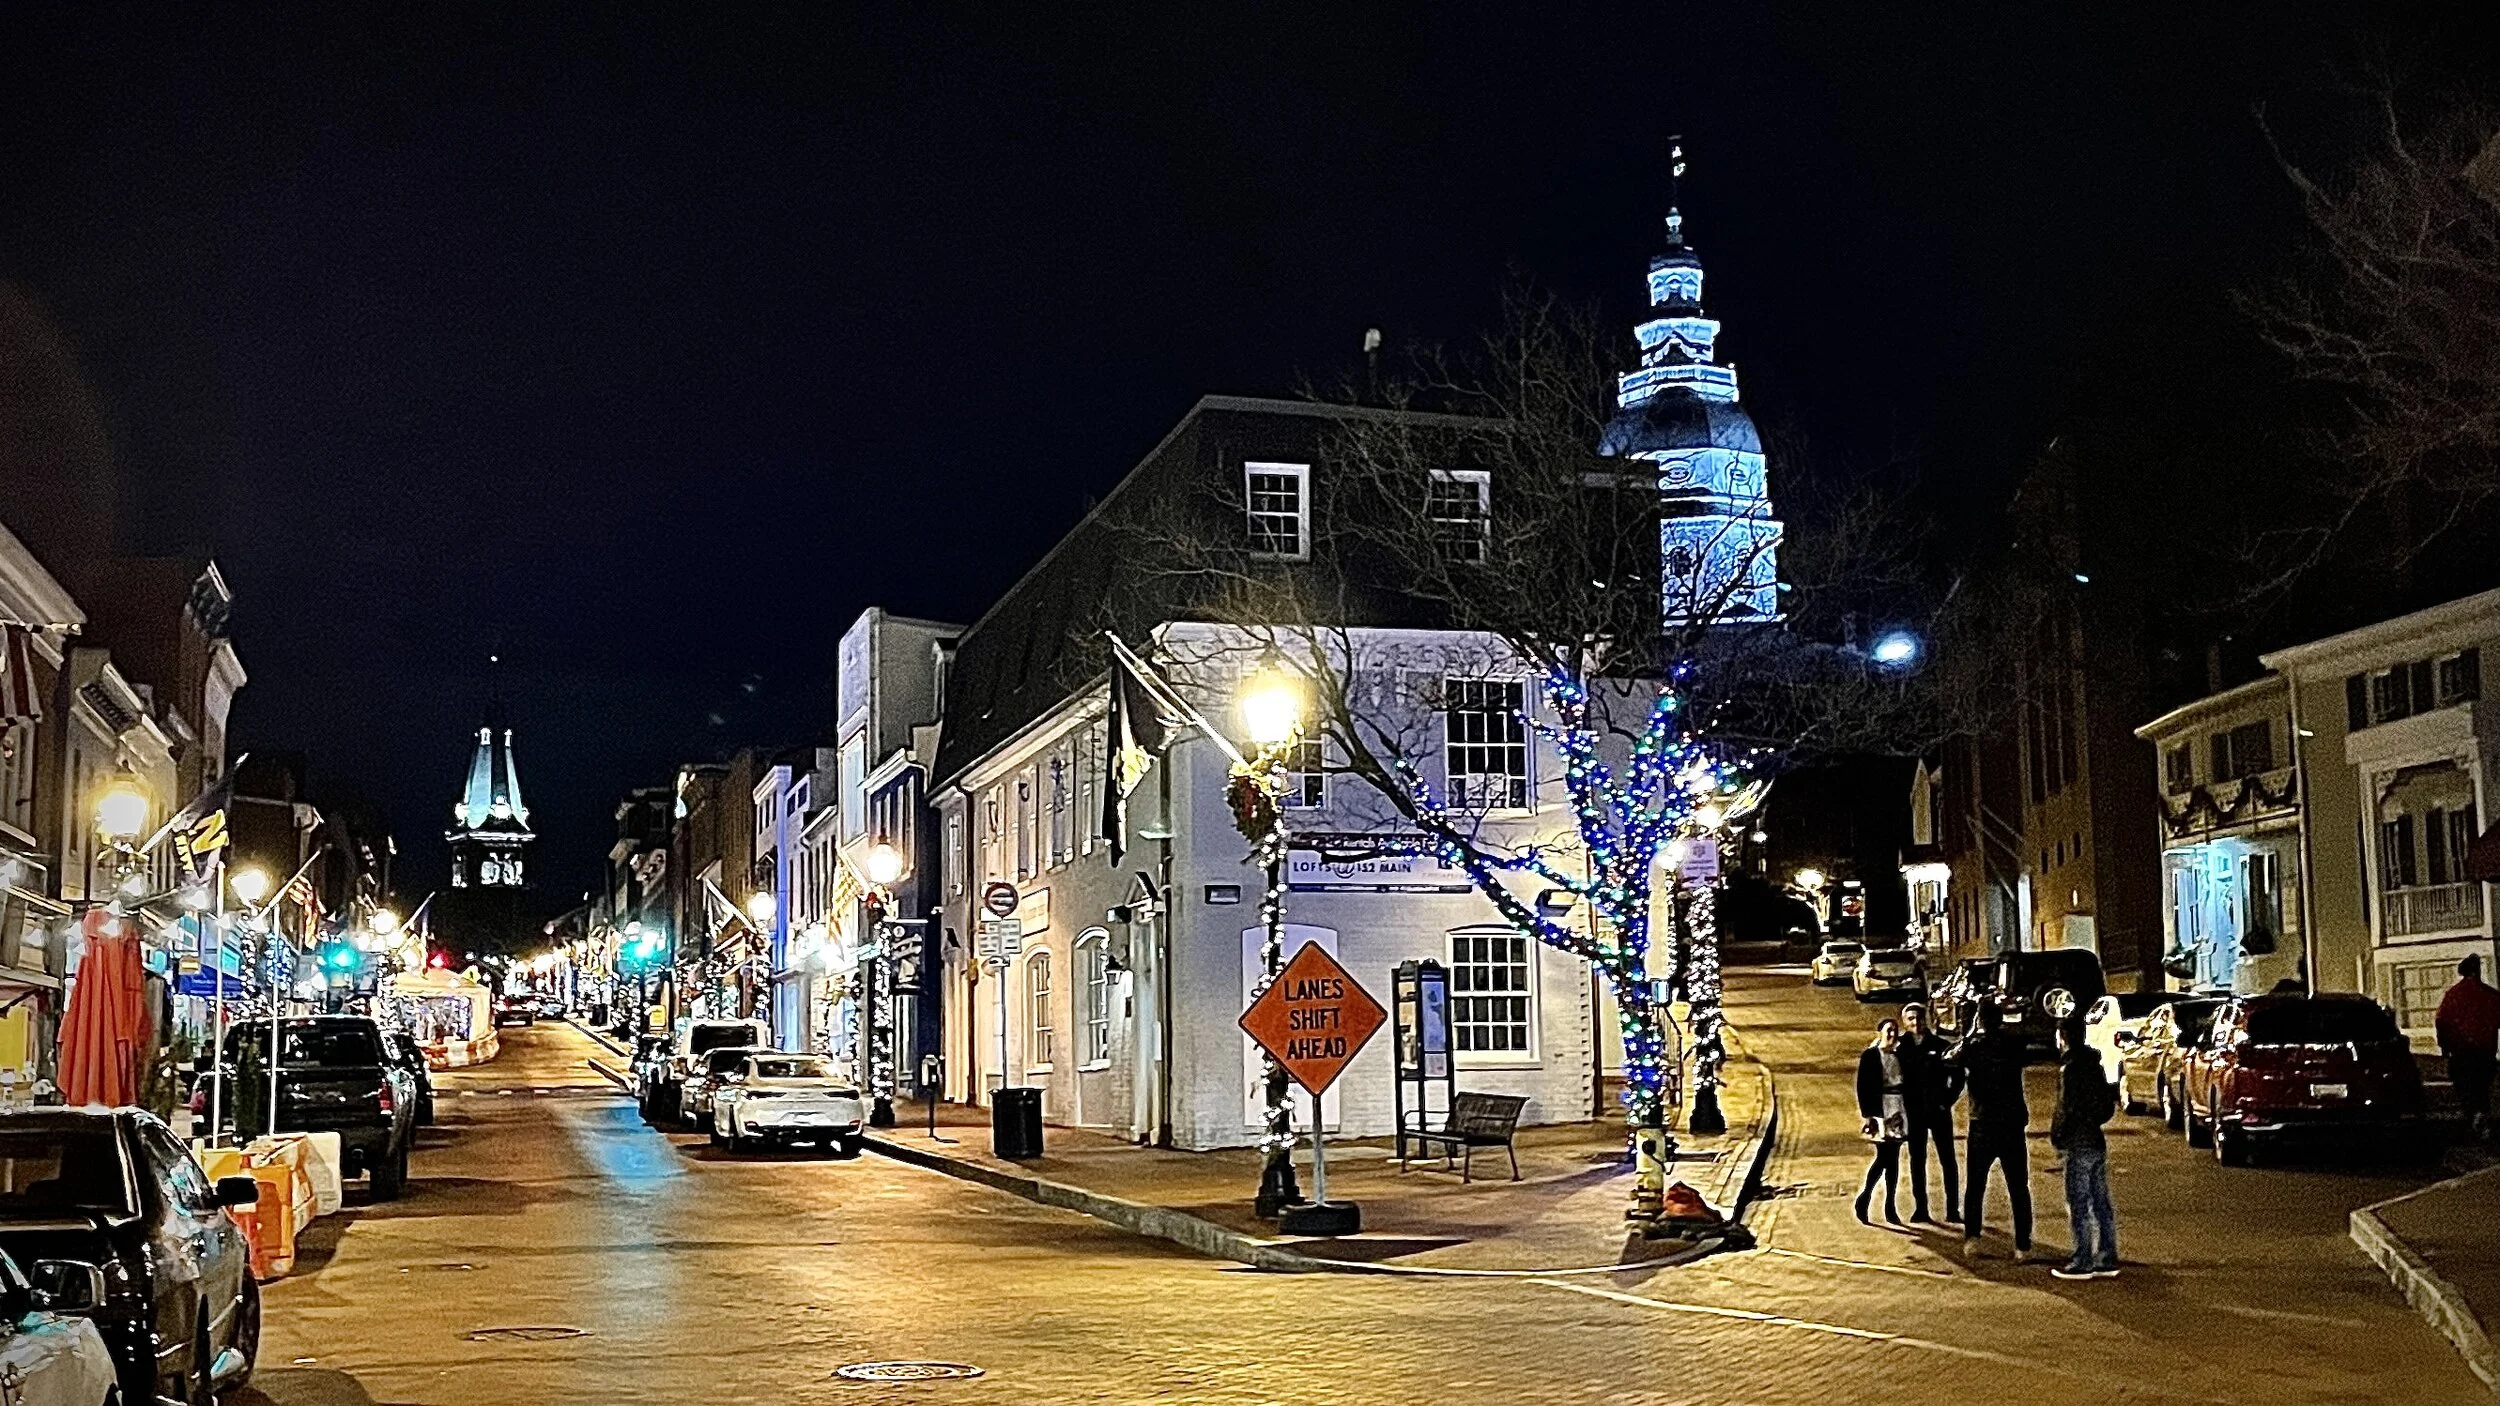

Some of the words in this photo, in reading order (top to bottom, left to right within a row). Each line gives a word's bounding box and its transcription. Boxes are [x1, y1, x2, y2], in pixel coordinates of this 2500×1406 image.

[1293, 862, 1331, 872] LOFTS
[1357, 863, 1375, 873] 152
[1379, 863, 1411, 873] MAIN
[1284, 978, 1344, 1002] LANES
[1289, 1007, 1341, 1031] SHIFT
[1286, 1036, 1347, 1060] AHEAD
